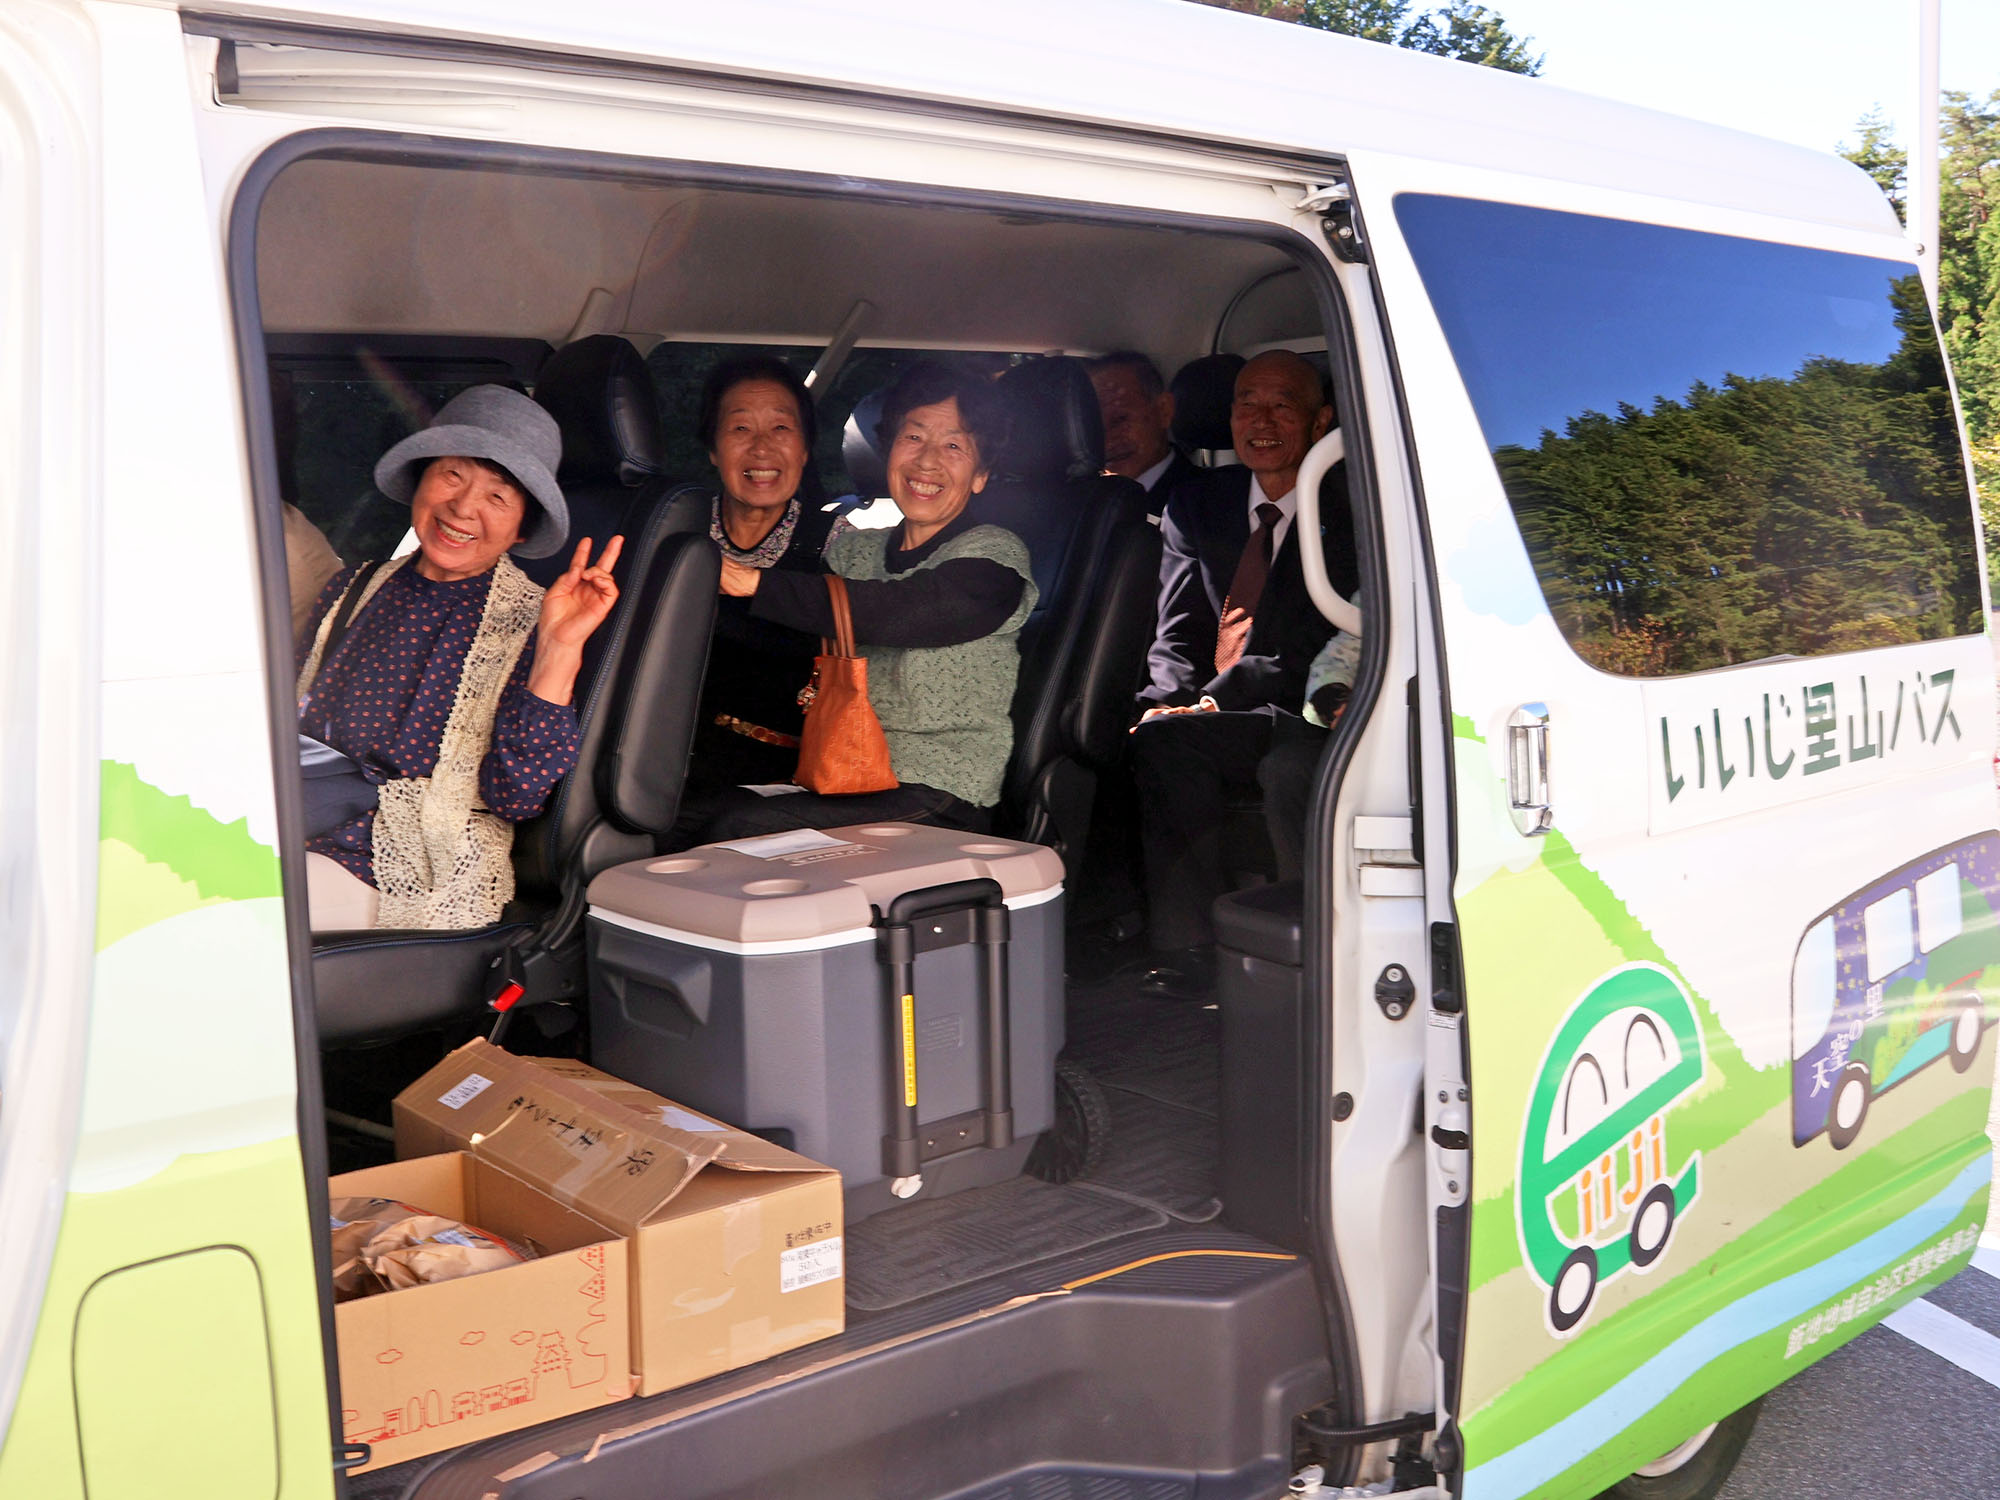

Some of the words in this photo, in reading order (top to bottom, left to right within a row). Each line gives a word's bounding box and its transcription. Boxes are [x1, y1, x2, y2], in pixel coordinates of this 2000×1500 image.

[1661, 668, 1962, 803] いいじ里山バス
[1810, 983, 1886, 1098] 天空の里
